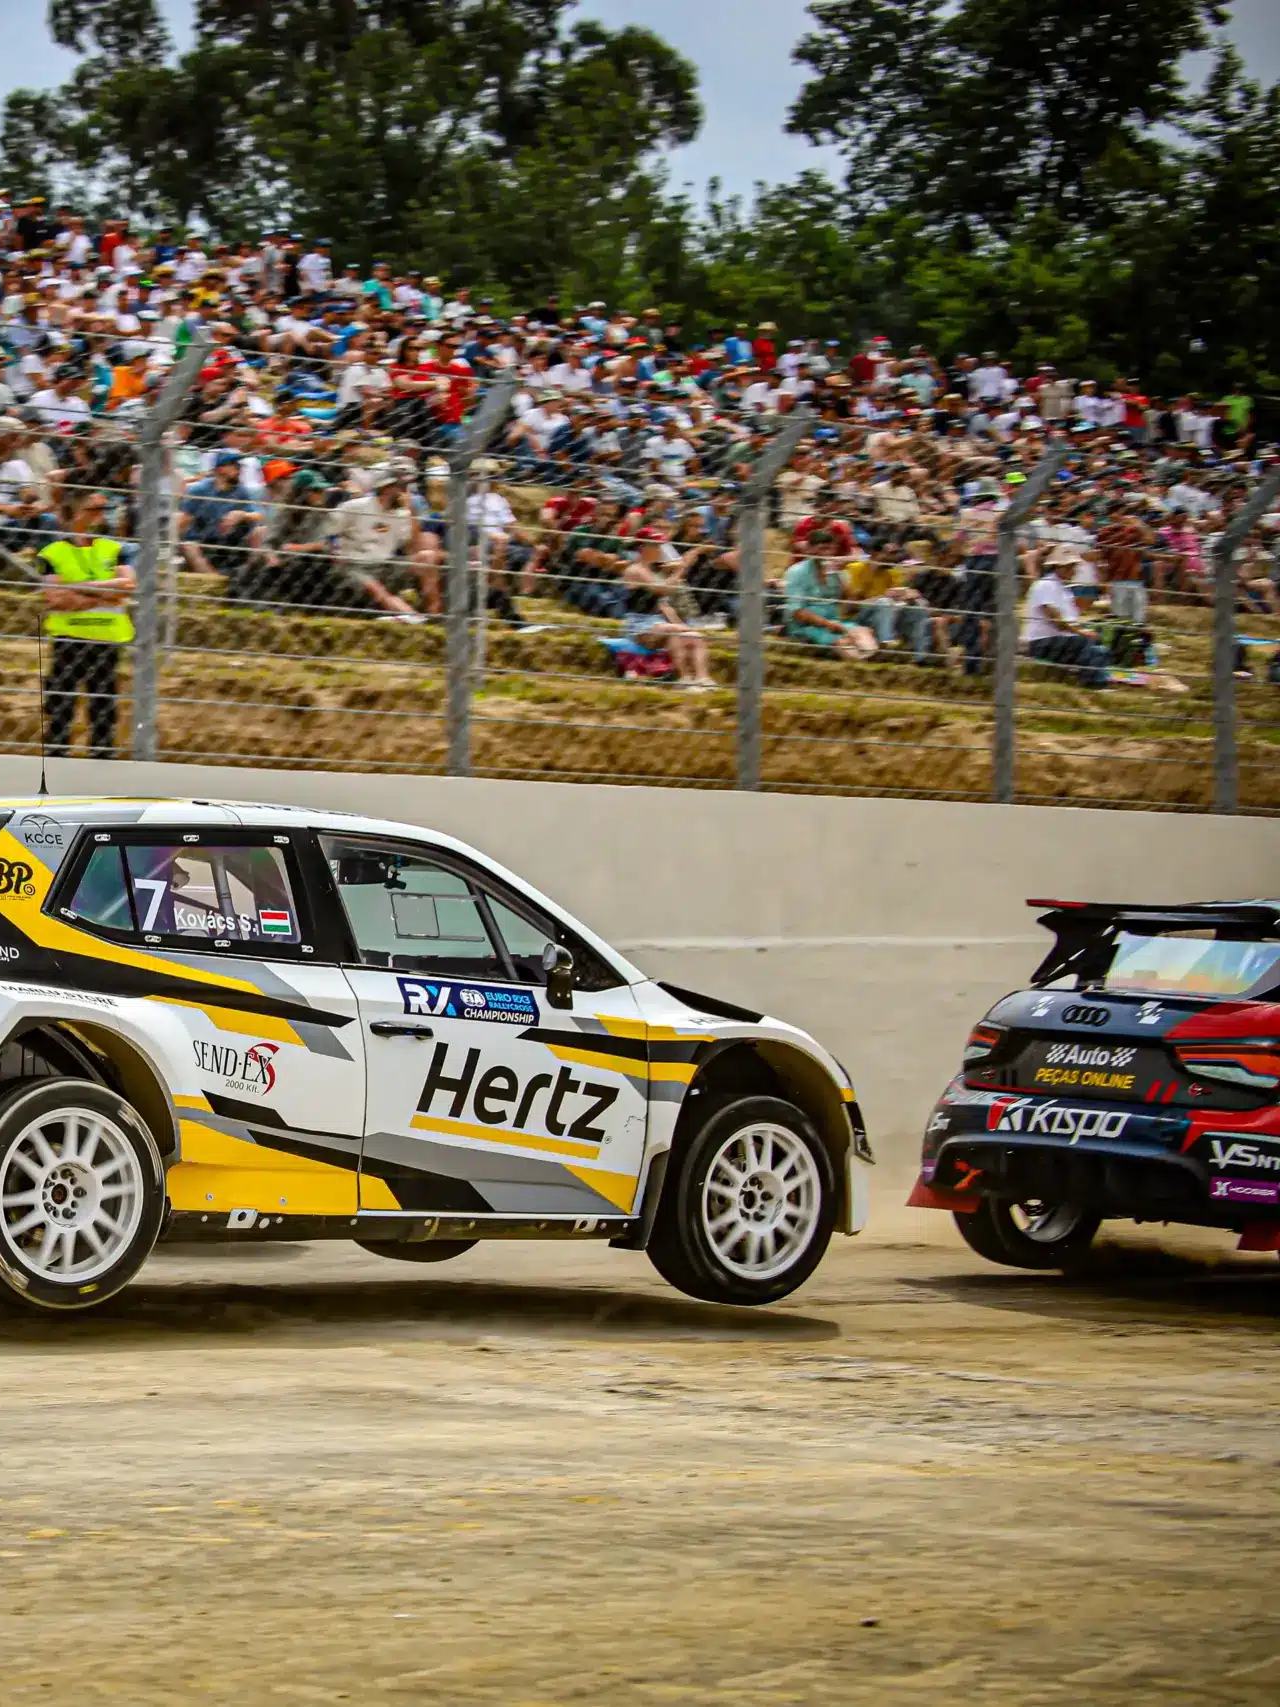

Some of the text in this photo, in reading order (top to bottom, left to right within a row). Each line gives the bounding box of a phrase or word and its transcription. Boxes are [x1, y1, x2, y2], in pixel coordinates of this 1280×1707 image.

[24, 833, 63, 845] KCCE
[134, 878, 168, 931] 7
[174, 907, 236, 932] Kovács
[404, 983, 457, 1016] RX
[485, 991, 531, 1005] EURO RX3
[488, 1001, 534, 1013] RALLYCROSS
[464, 1008, 535, 1024] CHAMPIONSHIP
[1062, 1044, 1111, 1066] Auto
[225, 1079, 245, 1091] 2000
[1034, 1067, 1136, 1089] PEÇAS ONLINE
[416, 1041, 620, 1143] Hertz
